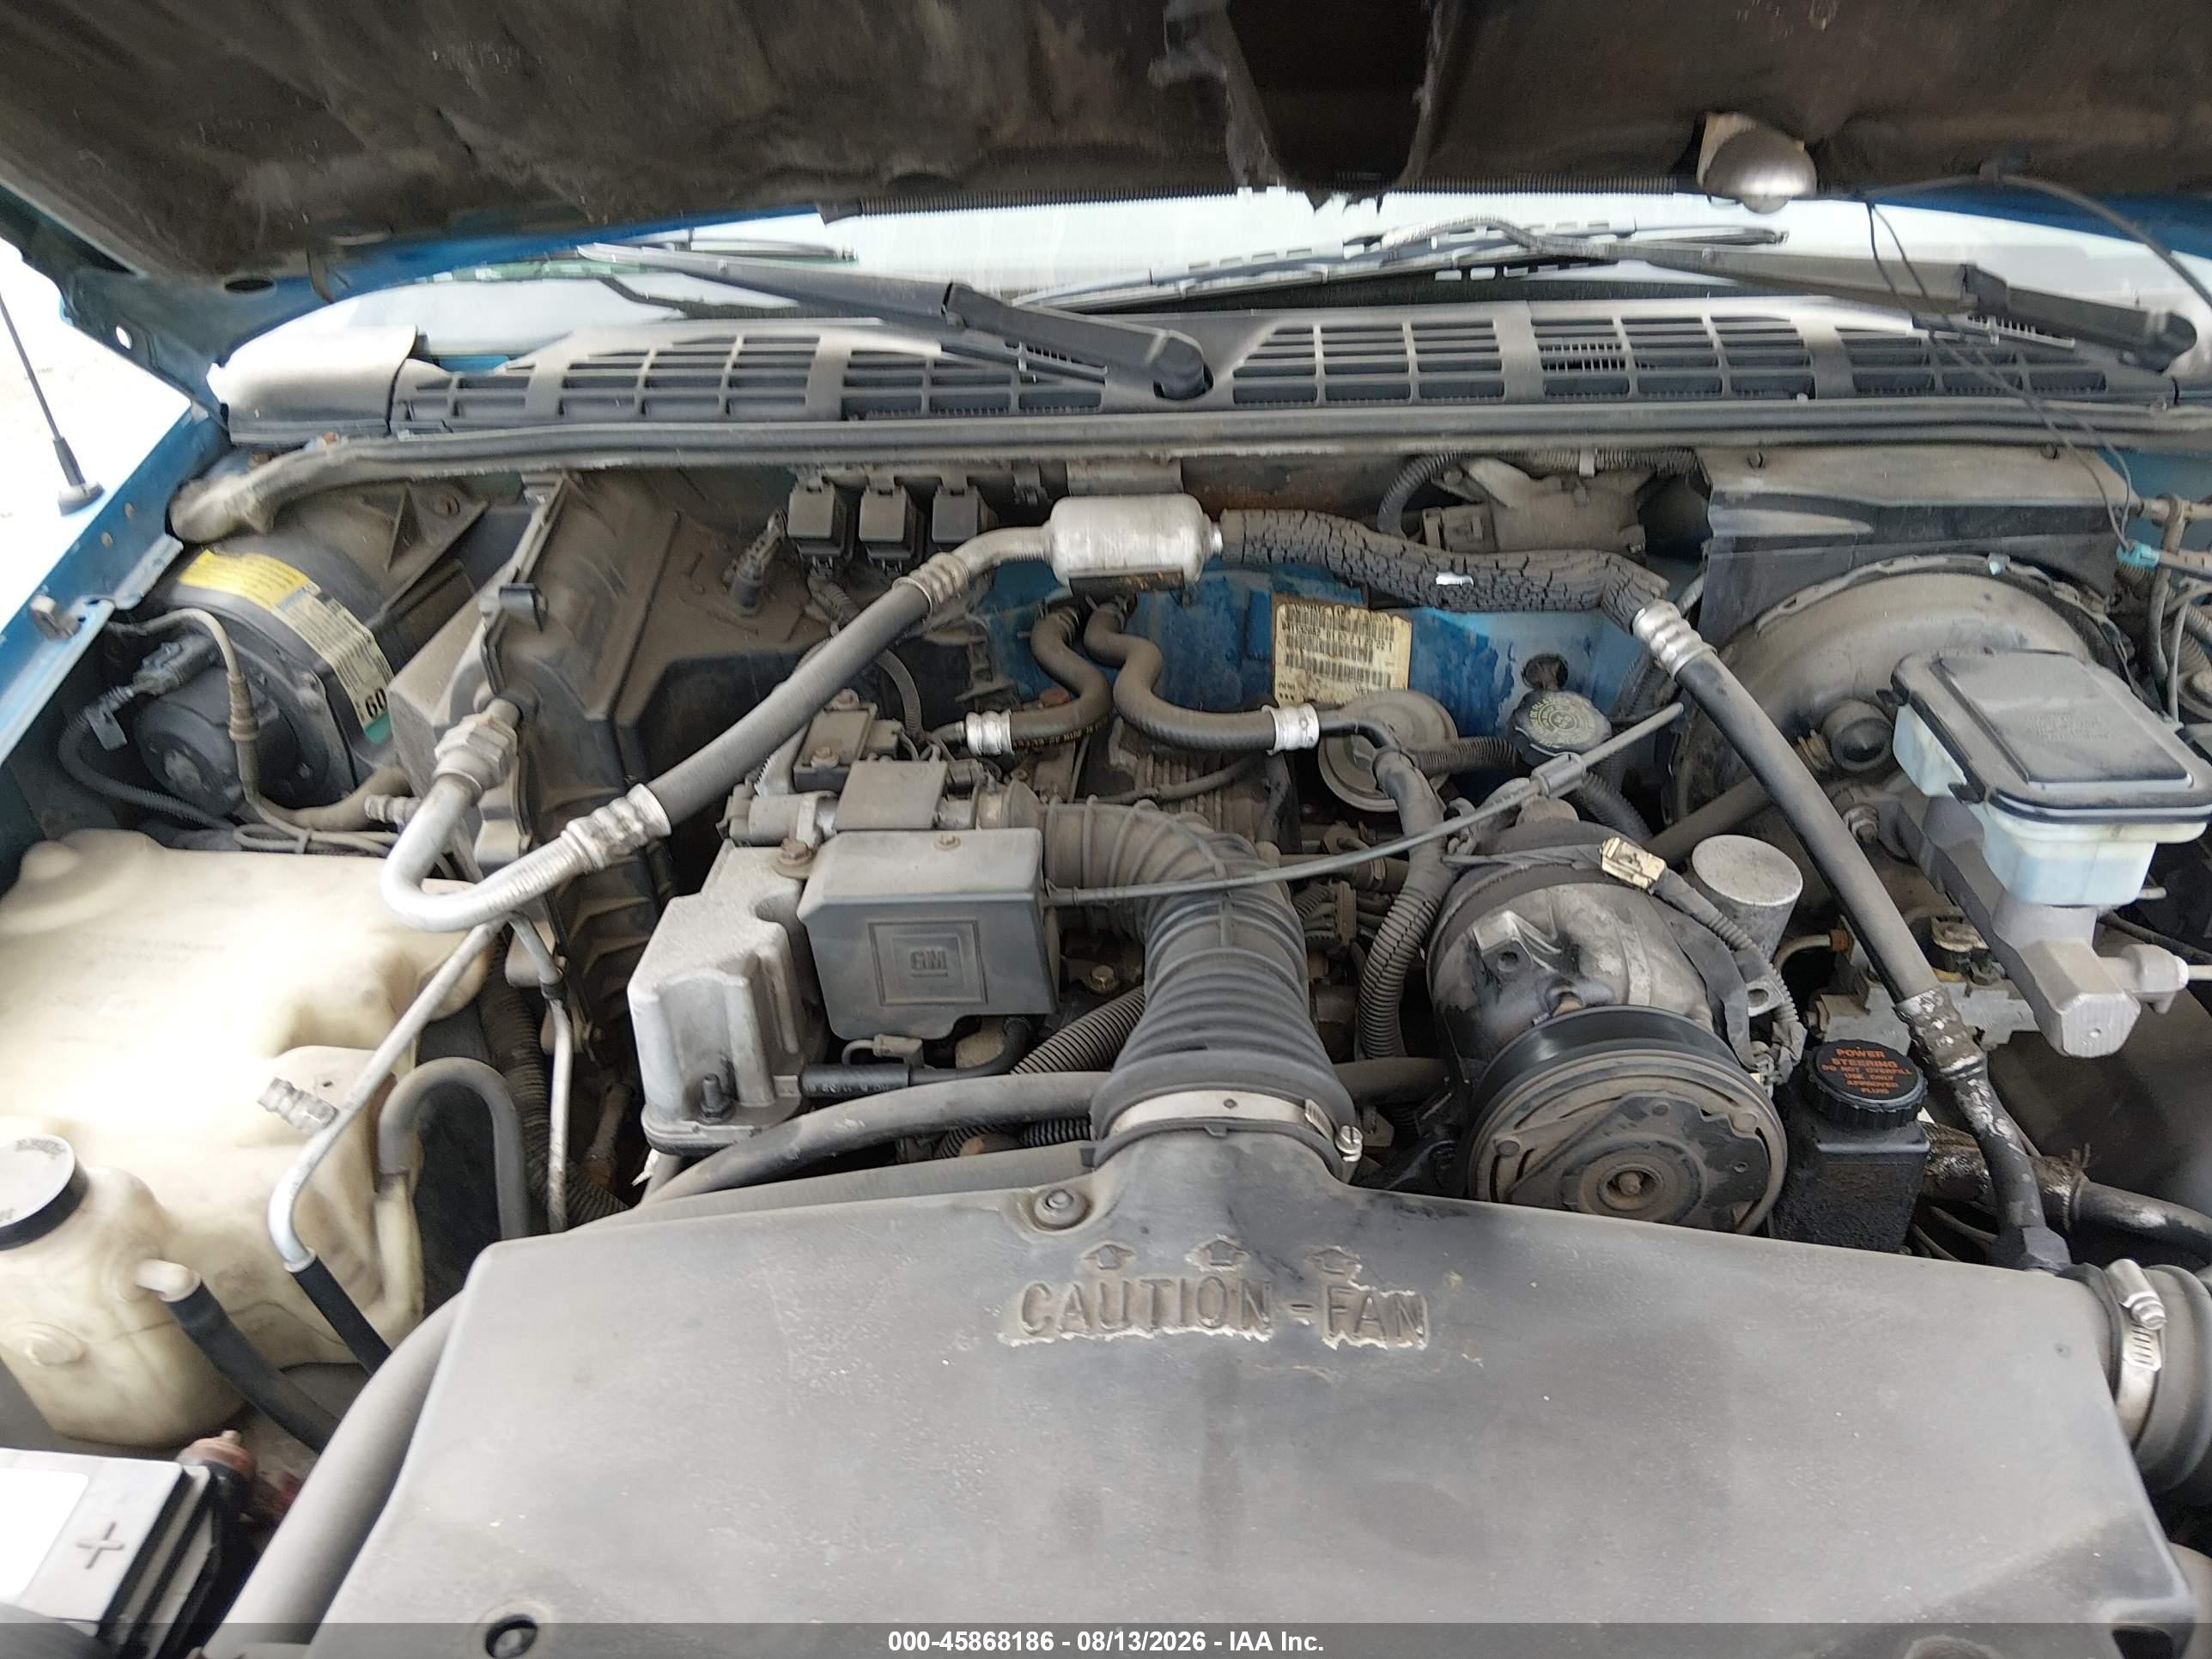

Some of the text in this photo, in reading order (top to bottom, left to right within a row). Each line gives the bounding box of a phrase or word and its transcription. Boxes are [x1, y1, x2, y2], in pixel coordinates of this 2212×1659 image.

[909, 949, 948, 971] GM
[1836, 1048, 1885, 1058] POWER
[1832, 1058, 1898, 1067] STEERING
[1019, 1275, 1273, 1338] CAUTION
[1325, 1284, 1429, 1348] FAN
